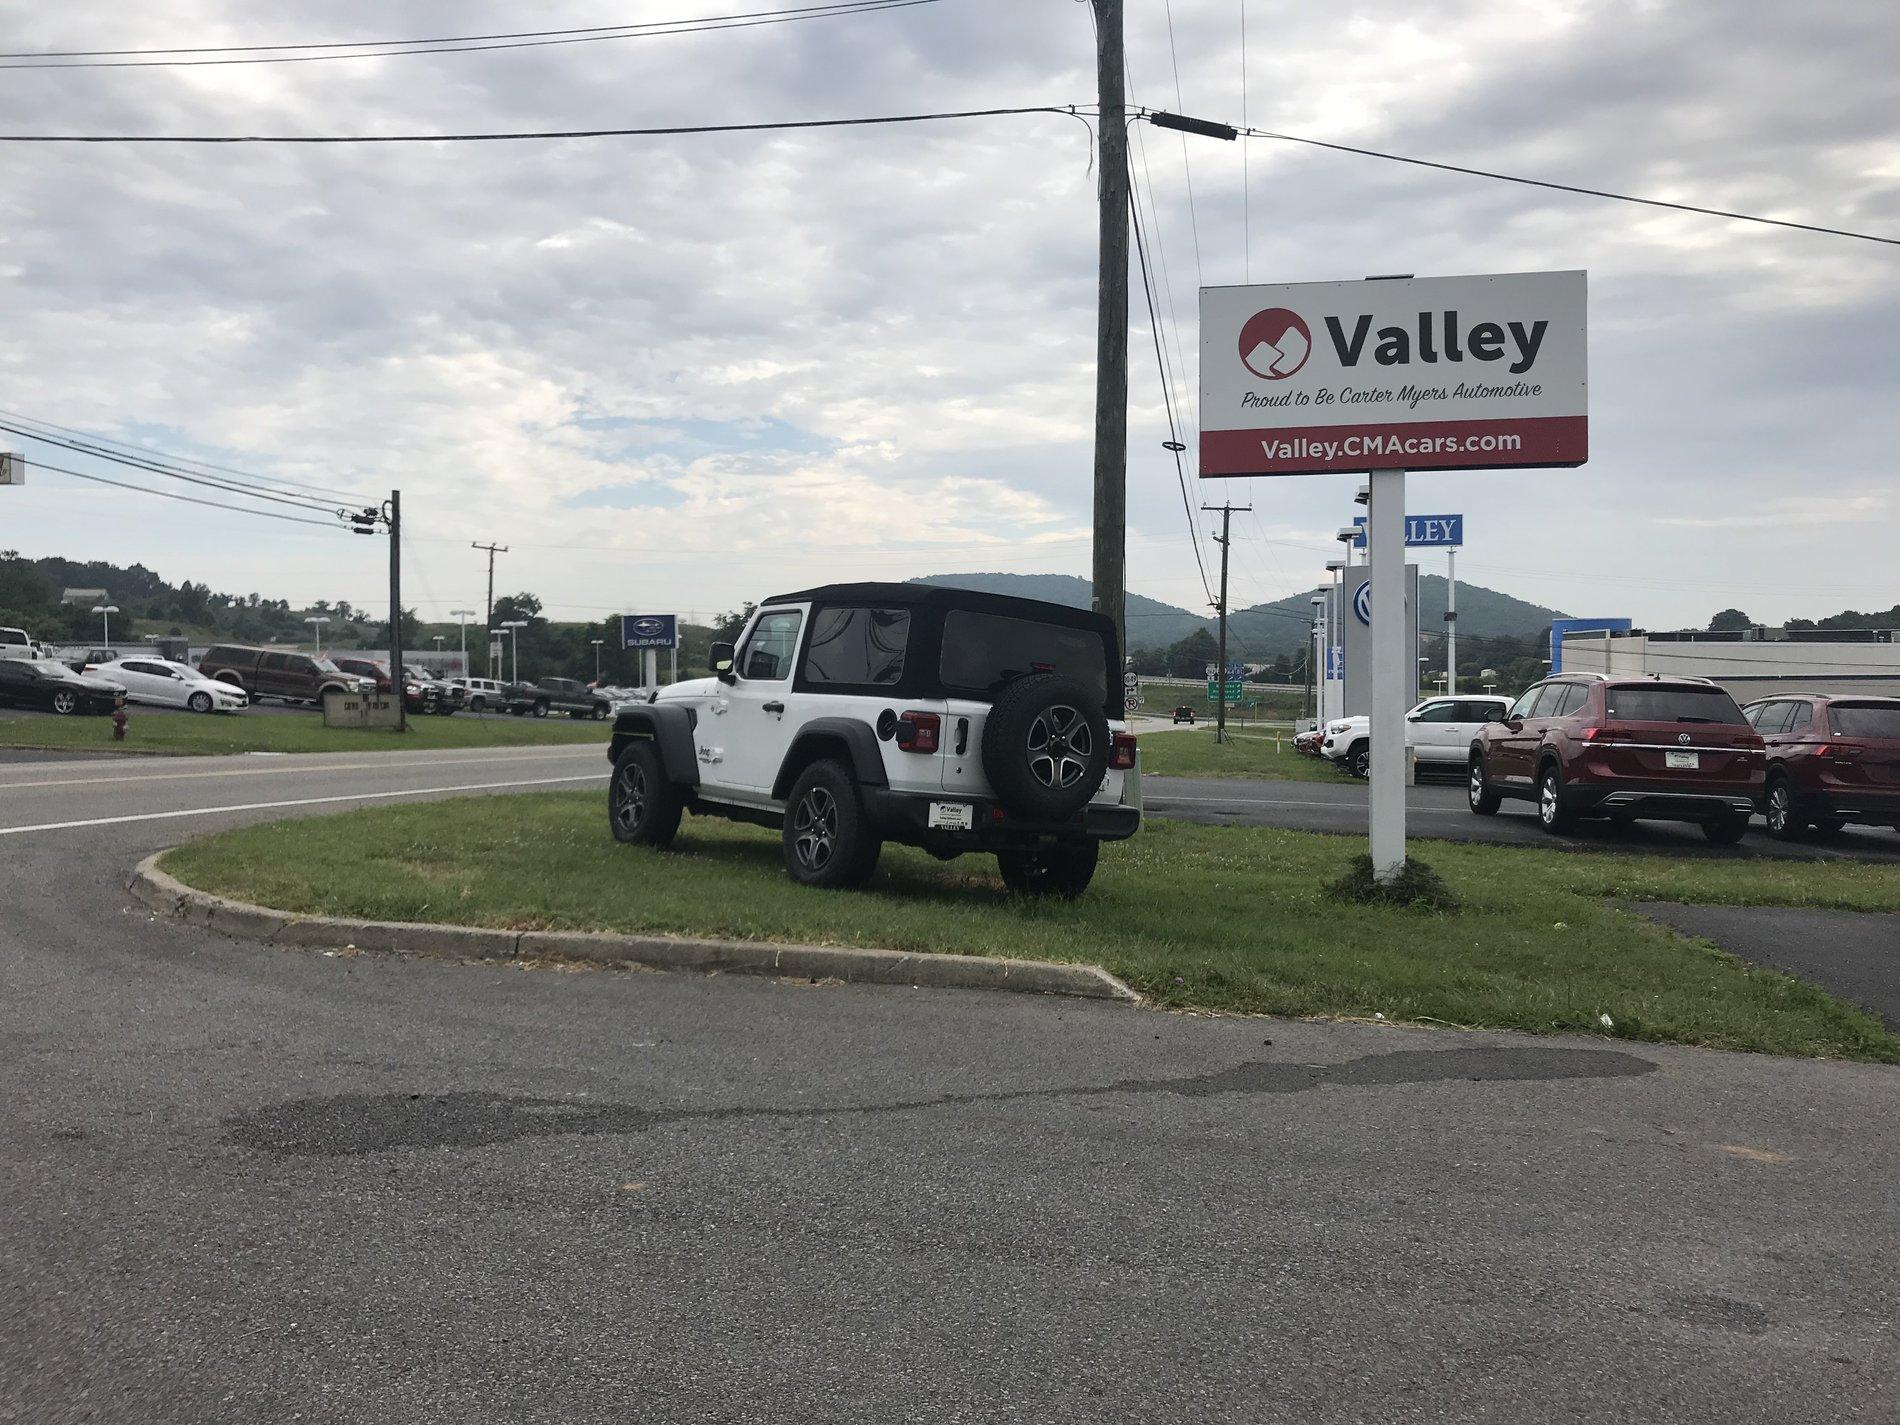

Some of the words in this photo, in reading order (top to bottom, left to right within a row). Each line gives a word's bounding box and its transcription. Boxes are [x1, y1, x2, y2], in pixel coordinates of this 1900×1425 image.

[1324, 310, 1549, 374] Valley
[1241, 390, 1293, 408] Proud
[1294, 390, 1310, 406] to
[1315, 388, 1335, 405] Be
[1340, 386, 1394, 404] Carter
[1396, 384, 1449, 410] Myers
[1452, 380, 1543, 399] Automotive
[1261, 434, 1521, 461] Valley.CMAcars.com
[627, 639, 672, 647] SUBARU
[946, 806, 963, 814] Valley
